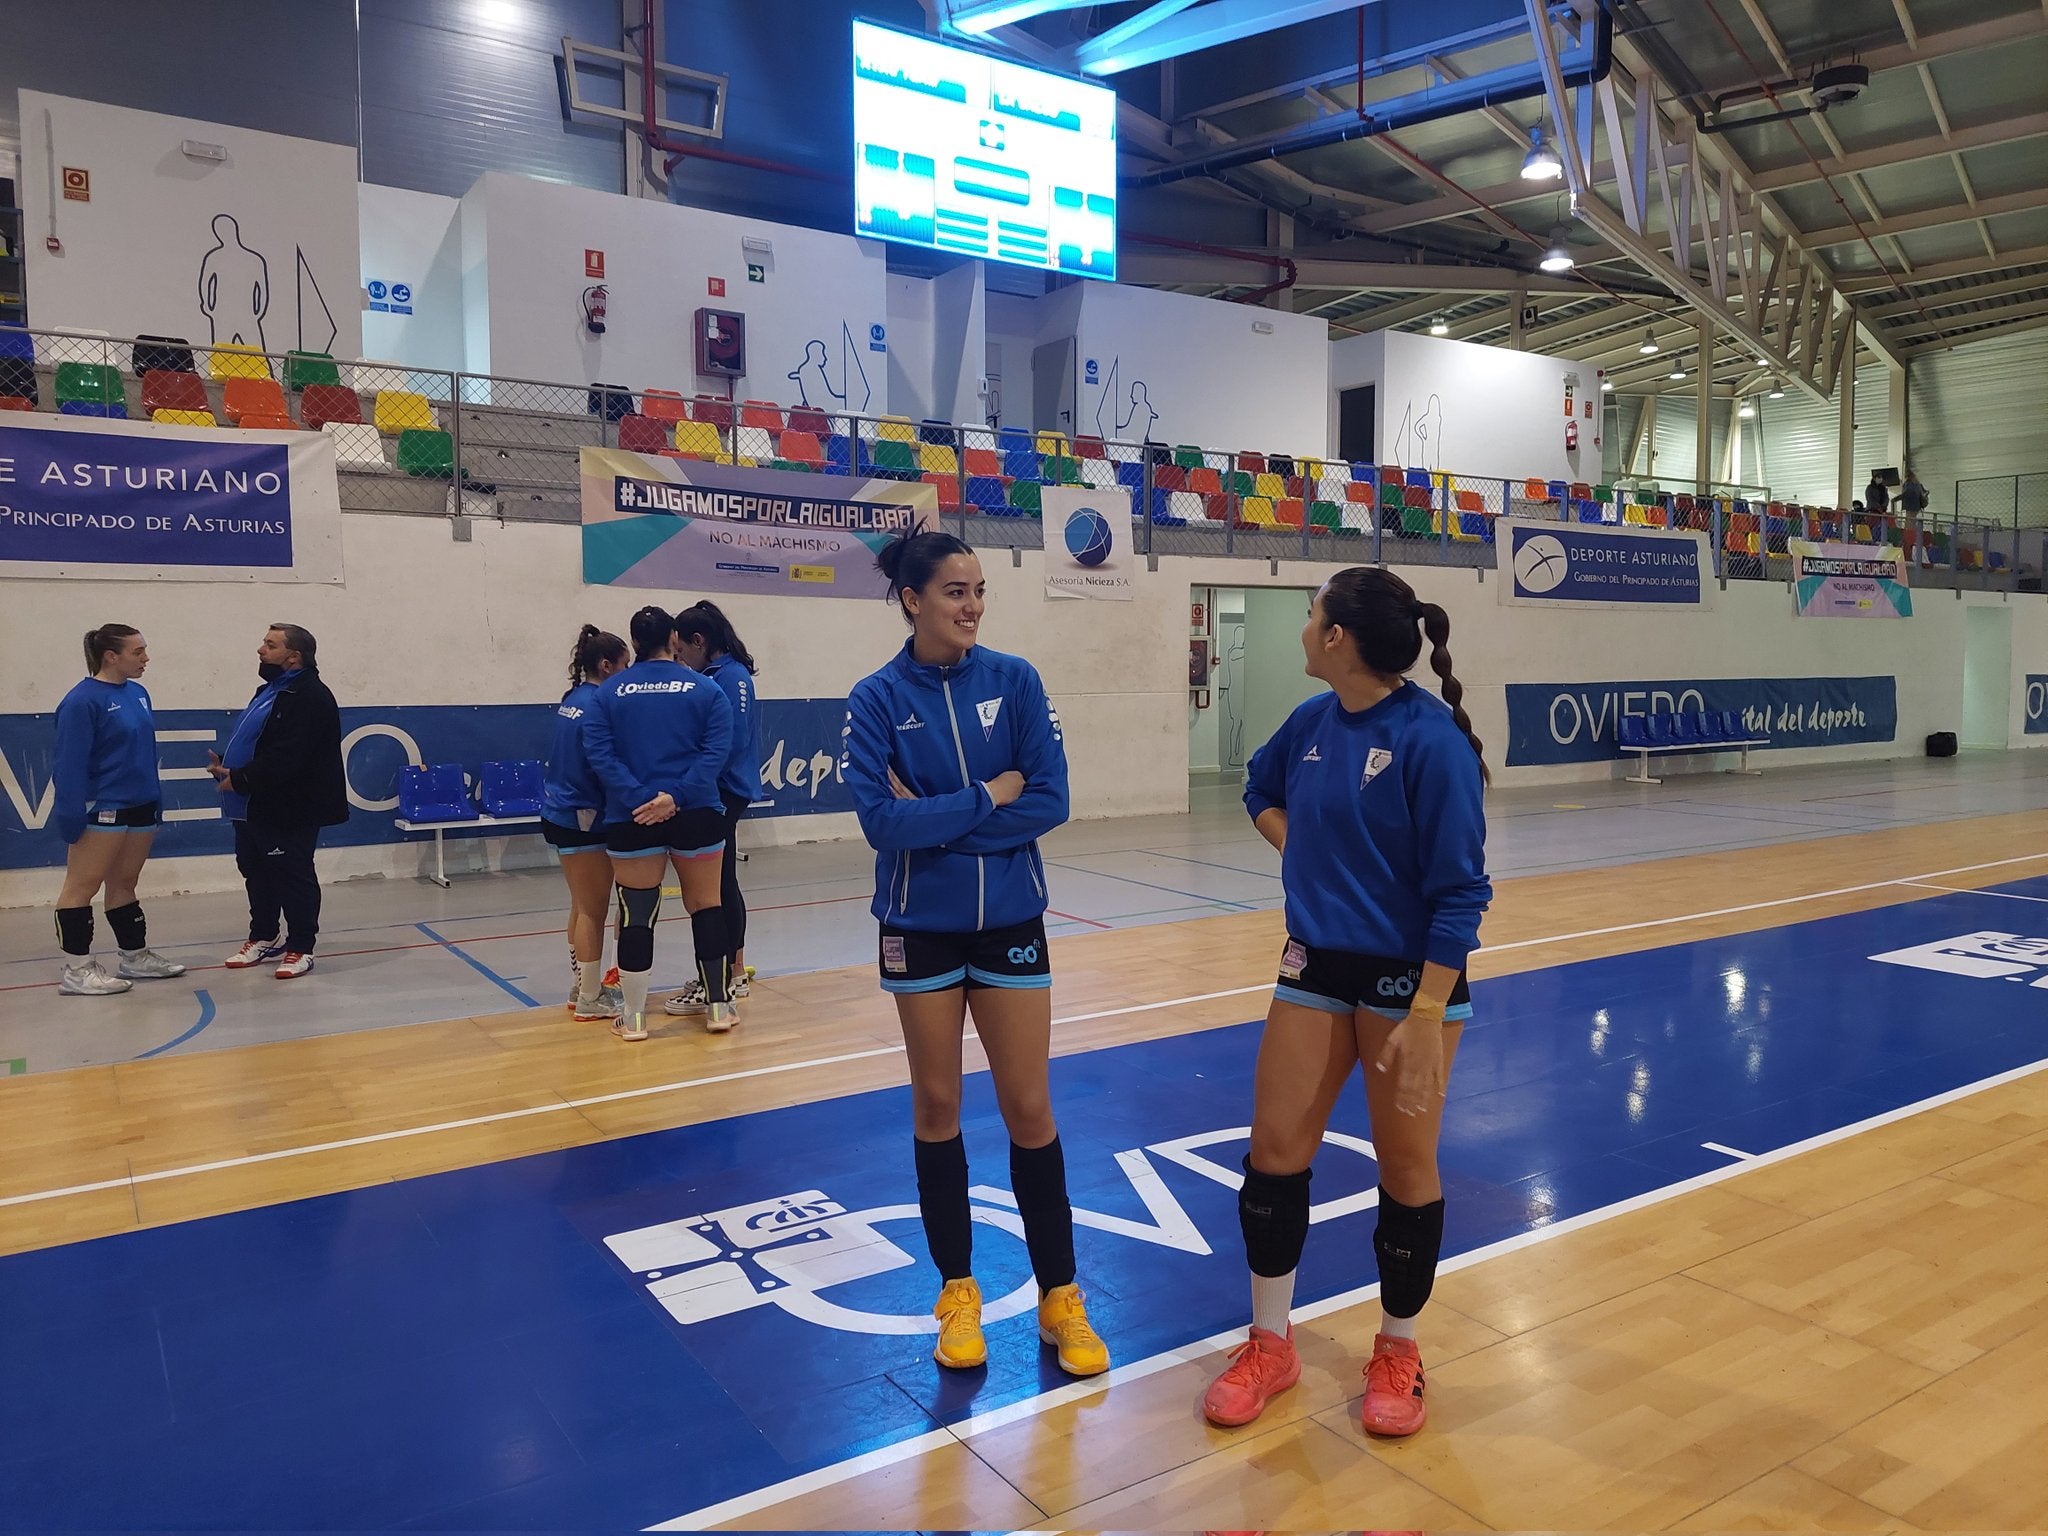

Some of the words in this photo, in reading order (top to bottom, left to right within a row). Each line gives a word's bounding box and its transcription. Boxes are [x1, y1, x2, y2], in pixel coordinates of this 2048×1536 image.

[40, 461, 281, 495] ASTURIANO
[619, 482, 912, 529] #JUGAMOSPORLAIGUALDAD
[183, 513, 285, 535] ASTURIAS
[709, 531, 733, 544] NO
[738, 534, 756, 547] AL
[760, 536, 840, 552] MACHISMO
[1570, 548, 1626, 564] DEPORTE
[1631, 552, 1697, 567] ASTURIANO
[1086, 576, 1114, 587] Nicieza
[1777, 702, 1803, 732] del
[1808, 701, 1866, 736] deporte
[1008, 945, 1037, 964] GO
[1376, 976, 1413, 997] GO
